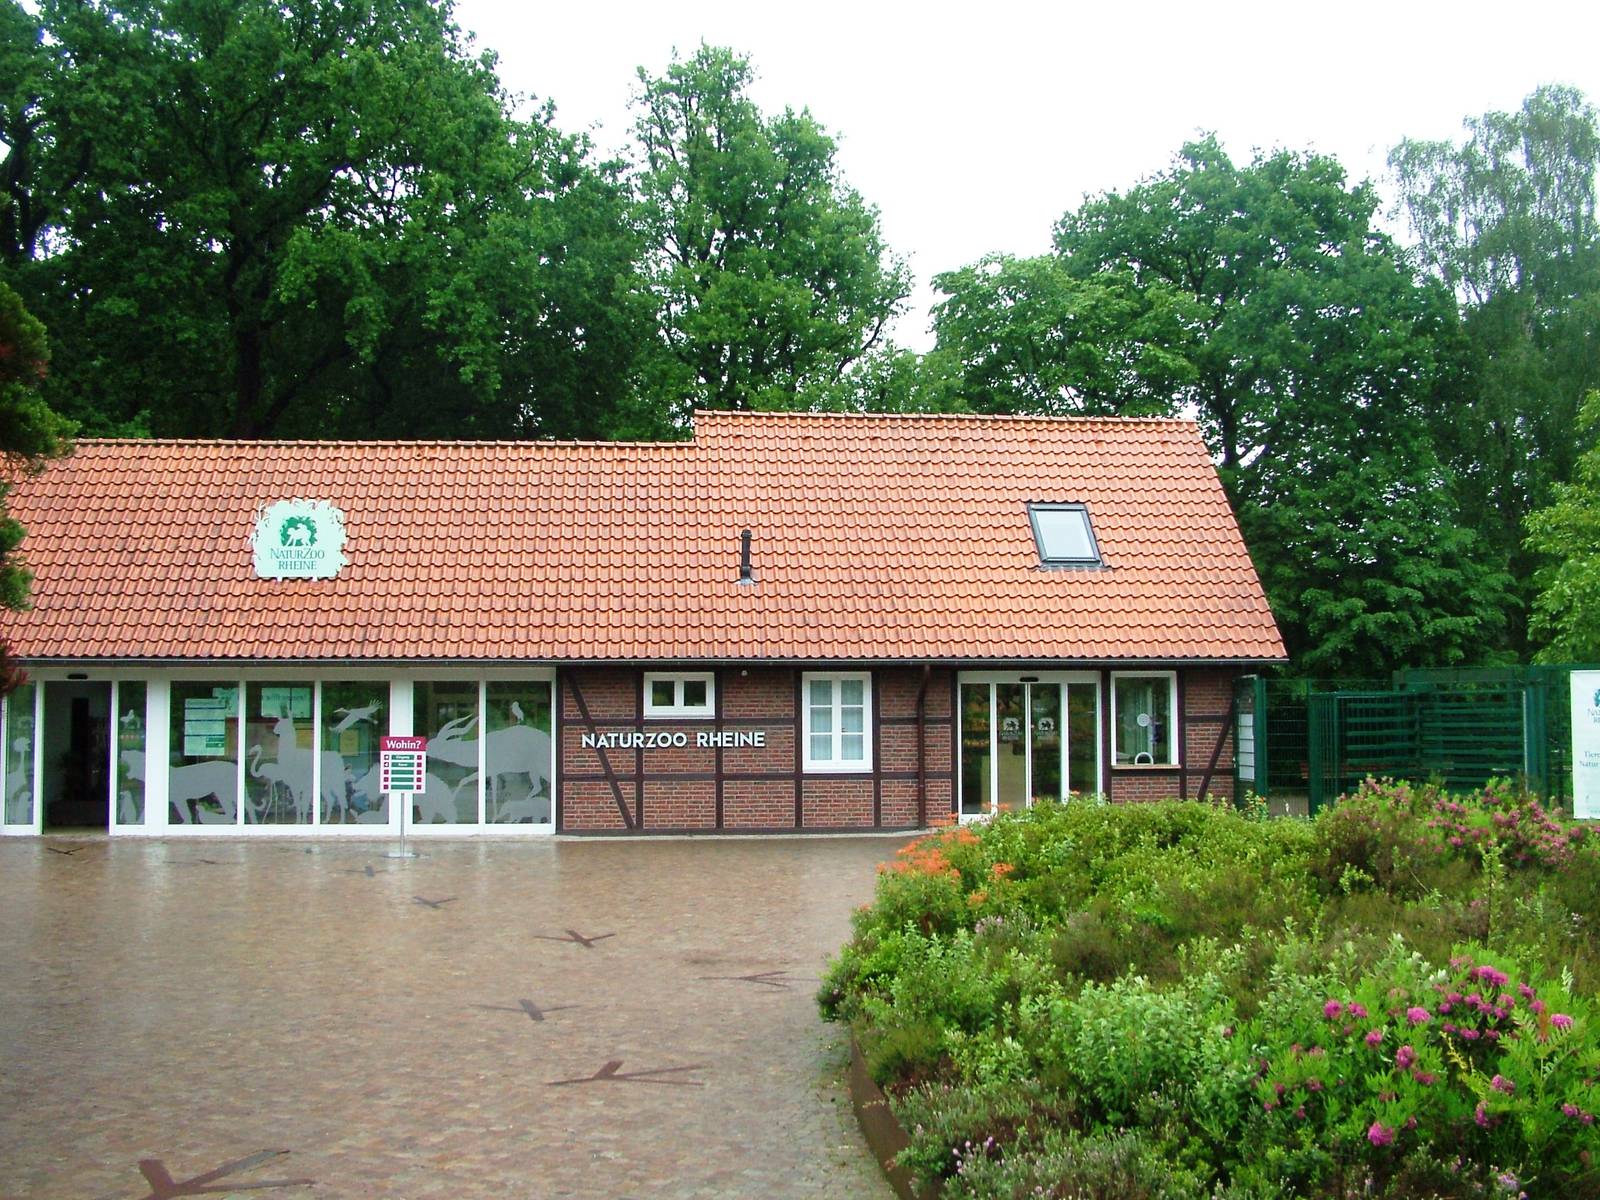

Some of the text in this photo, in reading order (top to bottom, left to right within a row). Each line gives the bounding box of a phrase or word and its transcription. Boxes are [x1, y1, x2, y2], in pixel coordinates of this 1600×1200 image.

[278, 560, 318, 570] RHEINE
[386, 740, 421, 749] Wohin?
[581, 732, 766, 748] NATURZOO RHEINE
